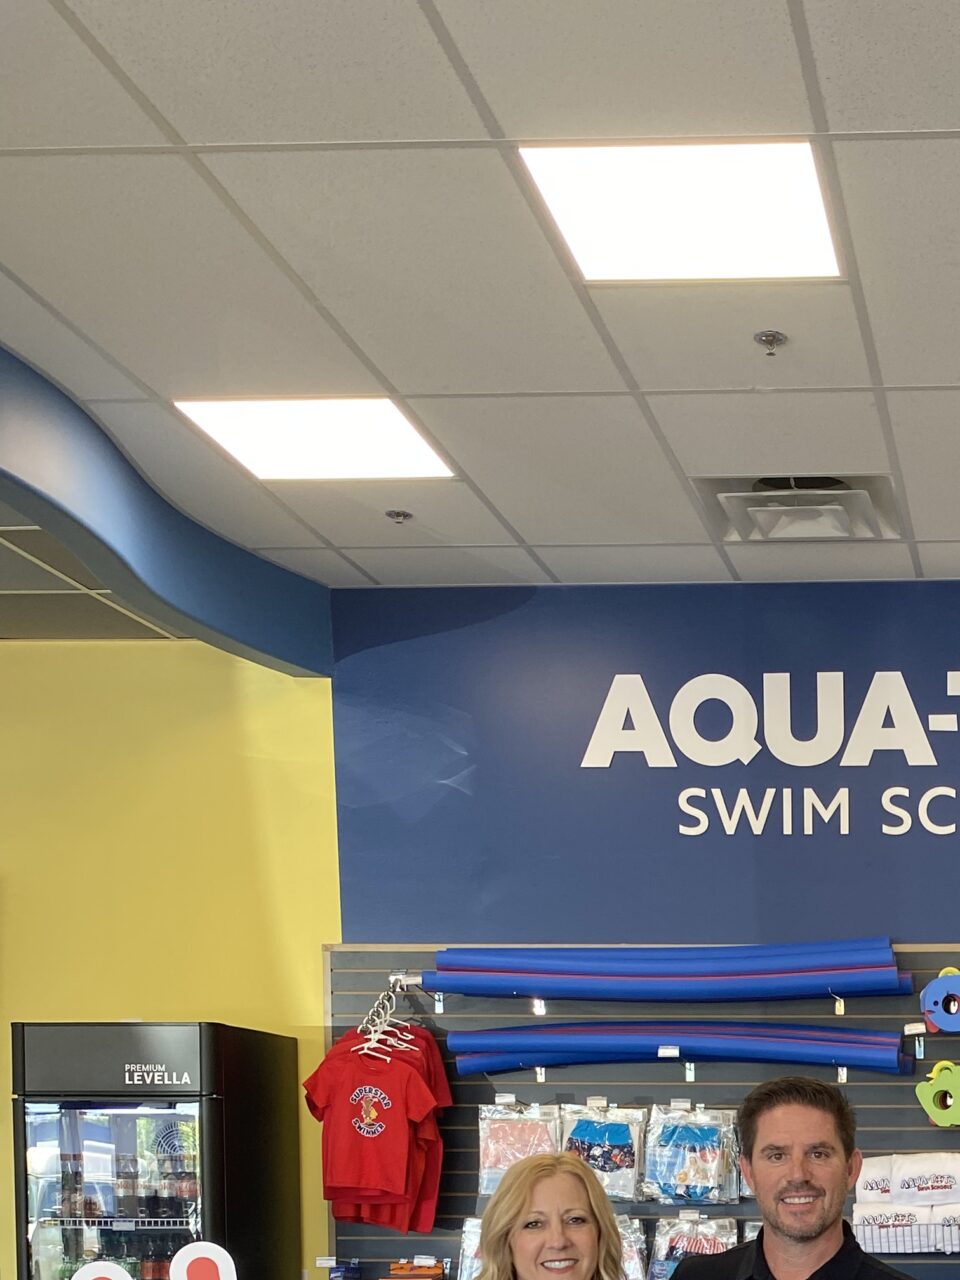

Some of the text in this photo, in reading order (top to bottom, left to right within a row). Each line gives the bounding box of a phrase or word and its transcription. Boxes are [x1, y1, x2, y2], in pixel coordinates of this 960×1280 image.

[677, 787, 850, 836] SWIM
[125, 1064, 166, 1072] PREMIUM
[125, 1072, 191, 1084] LEVELLA
[350, 1086, 392, 1109] SUPERSTAR
[352, 1118, 385, 1137] SWIMMER
